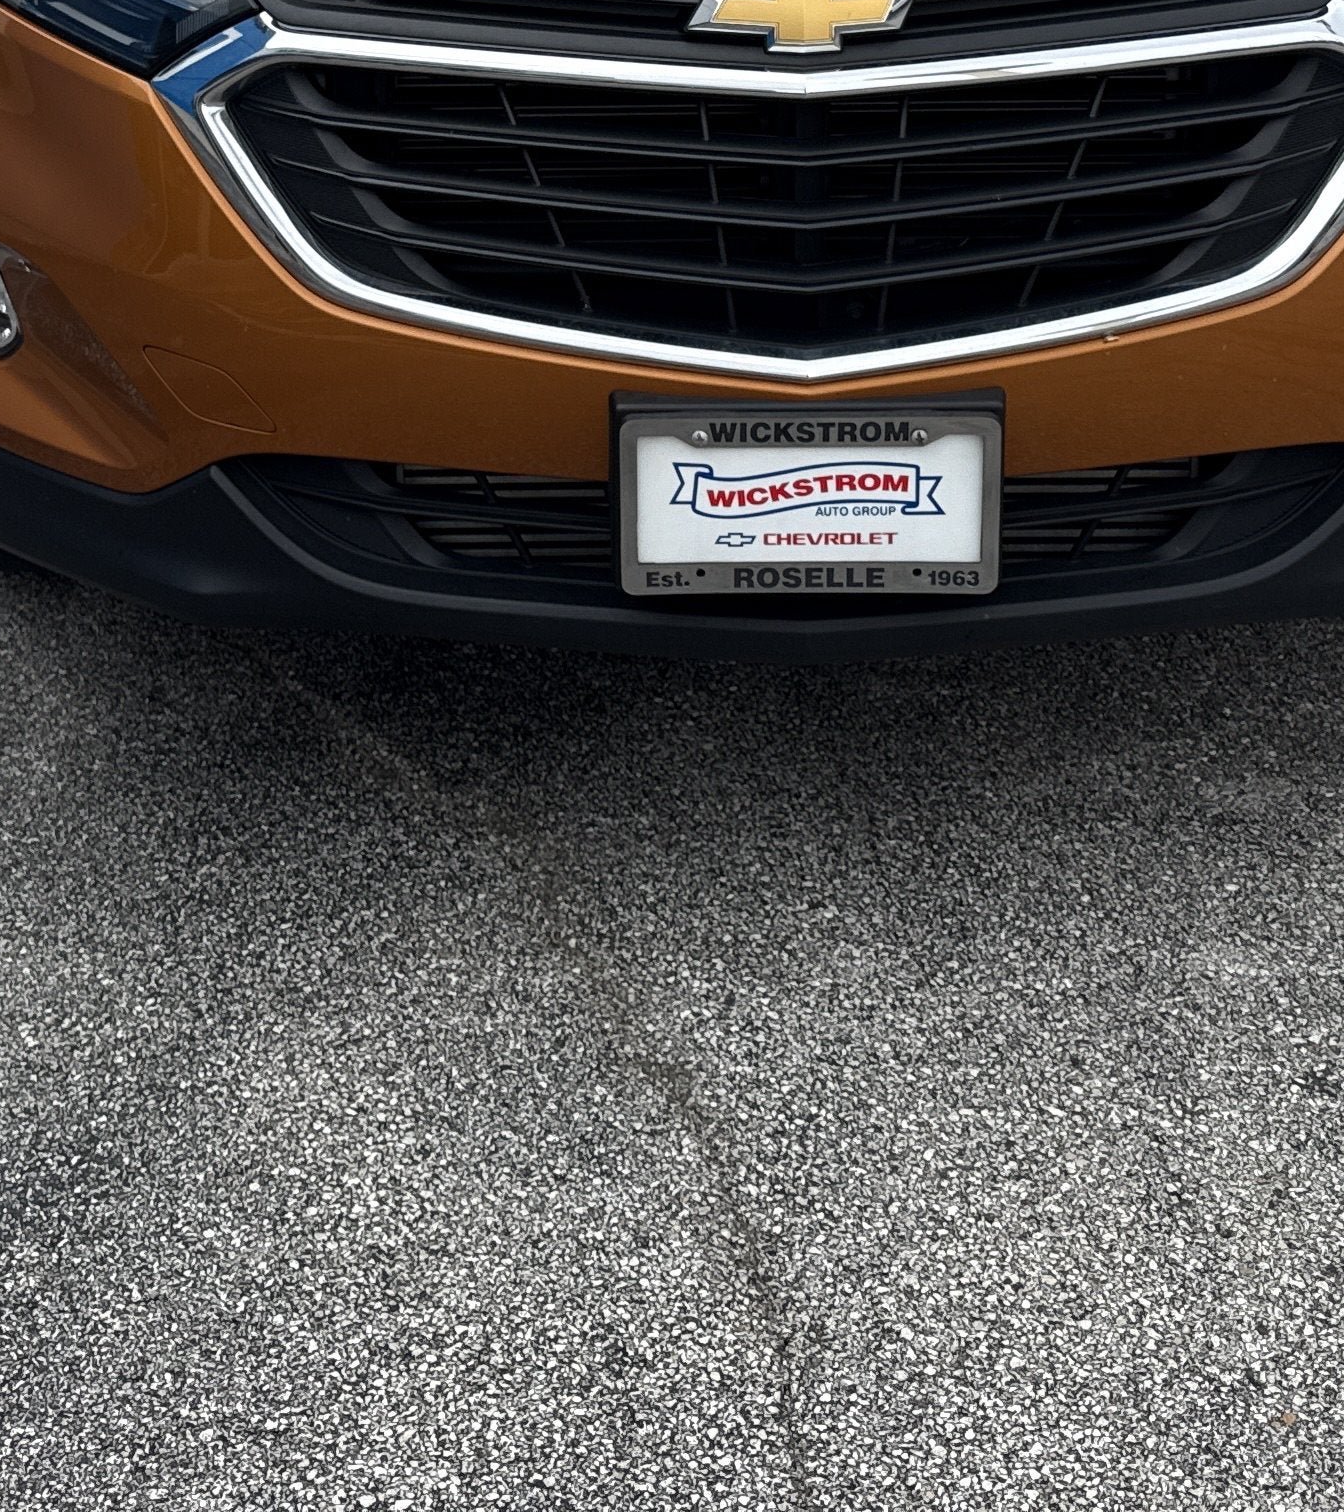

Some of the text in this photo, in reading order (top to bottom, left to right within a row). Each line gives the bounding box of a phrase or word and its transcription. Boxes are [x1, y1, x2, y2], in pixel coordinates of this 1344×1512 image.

[709, 421, 910, 443] WICKSTROM
[707, 473, 909, 507] WICKSTROM
[815, 506, 896, 516] AUTO GROUP
[762, 531, 898, 546] CHEVROLET
[645, 567, 980, 589] Est. ROSELLE 1963
